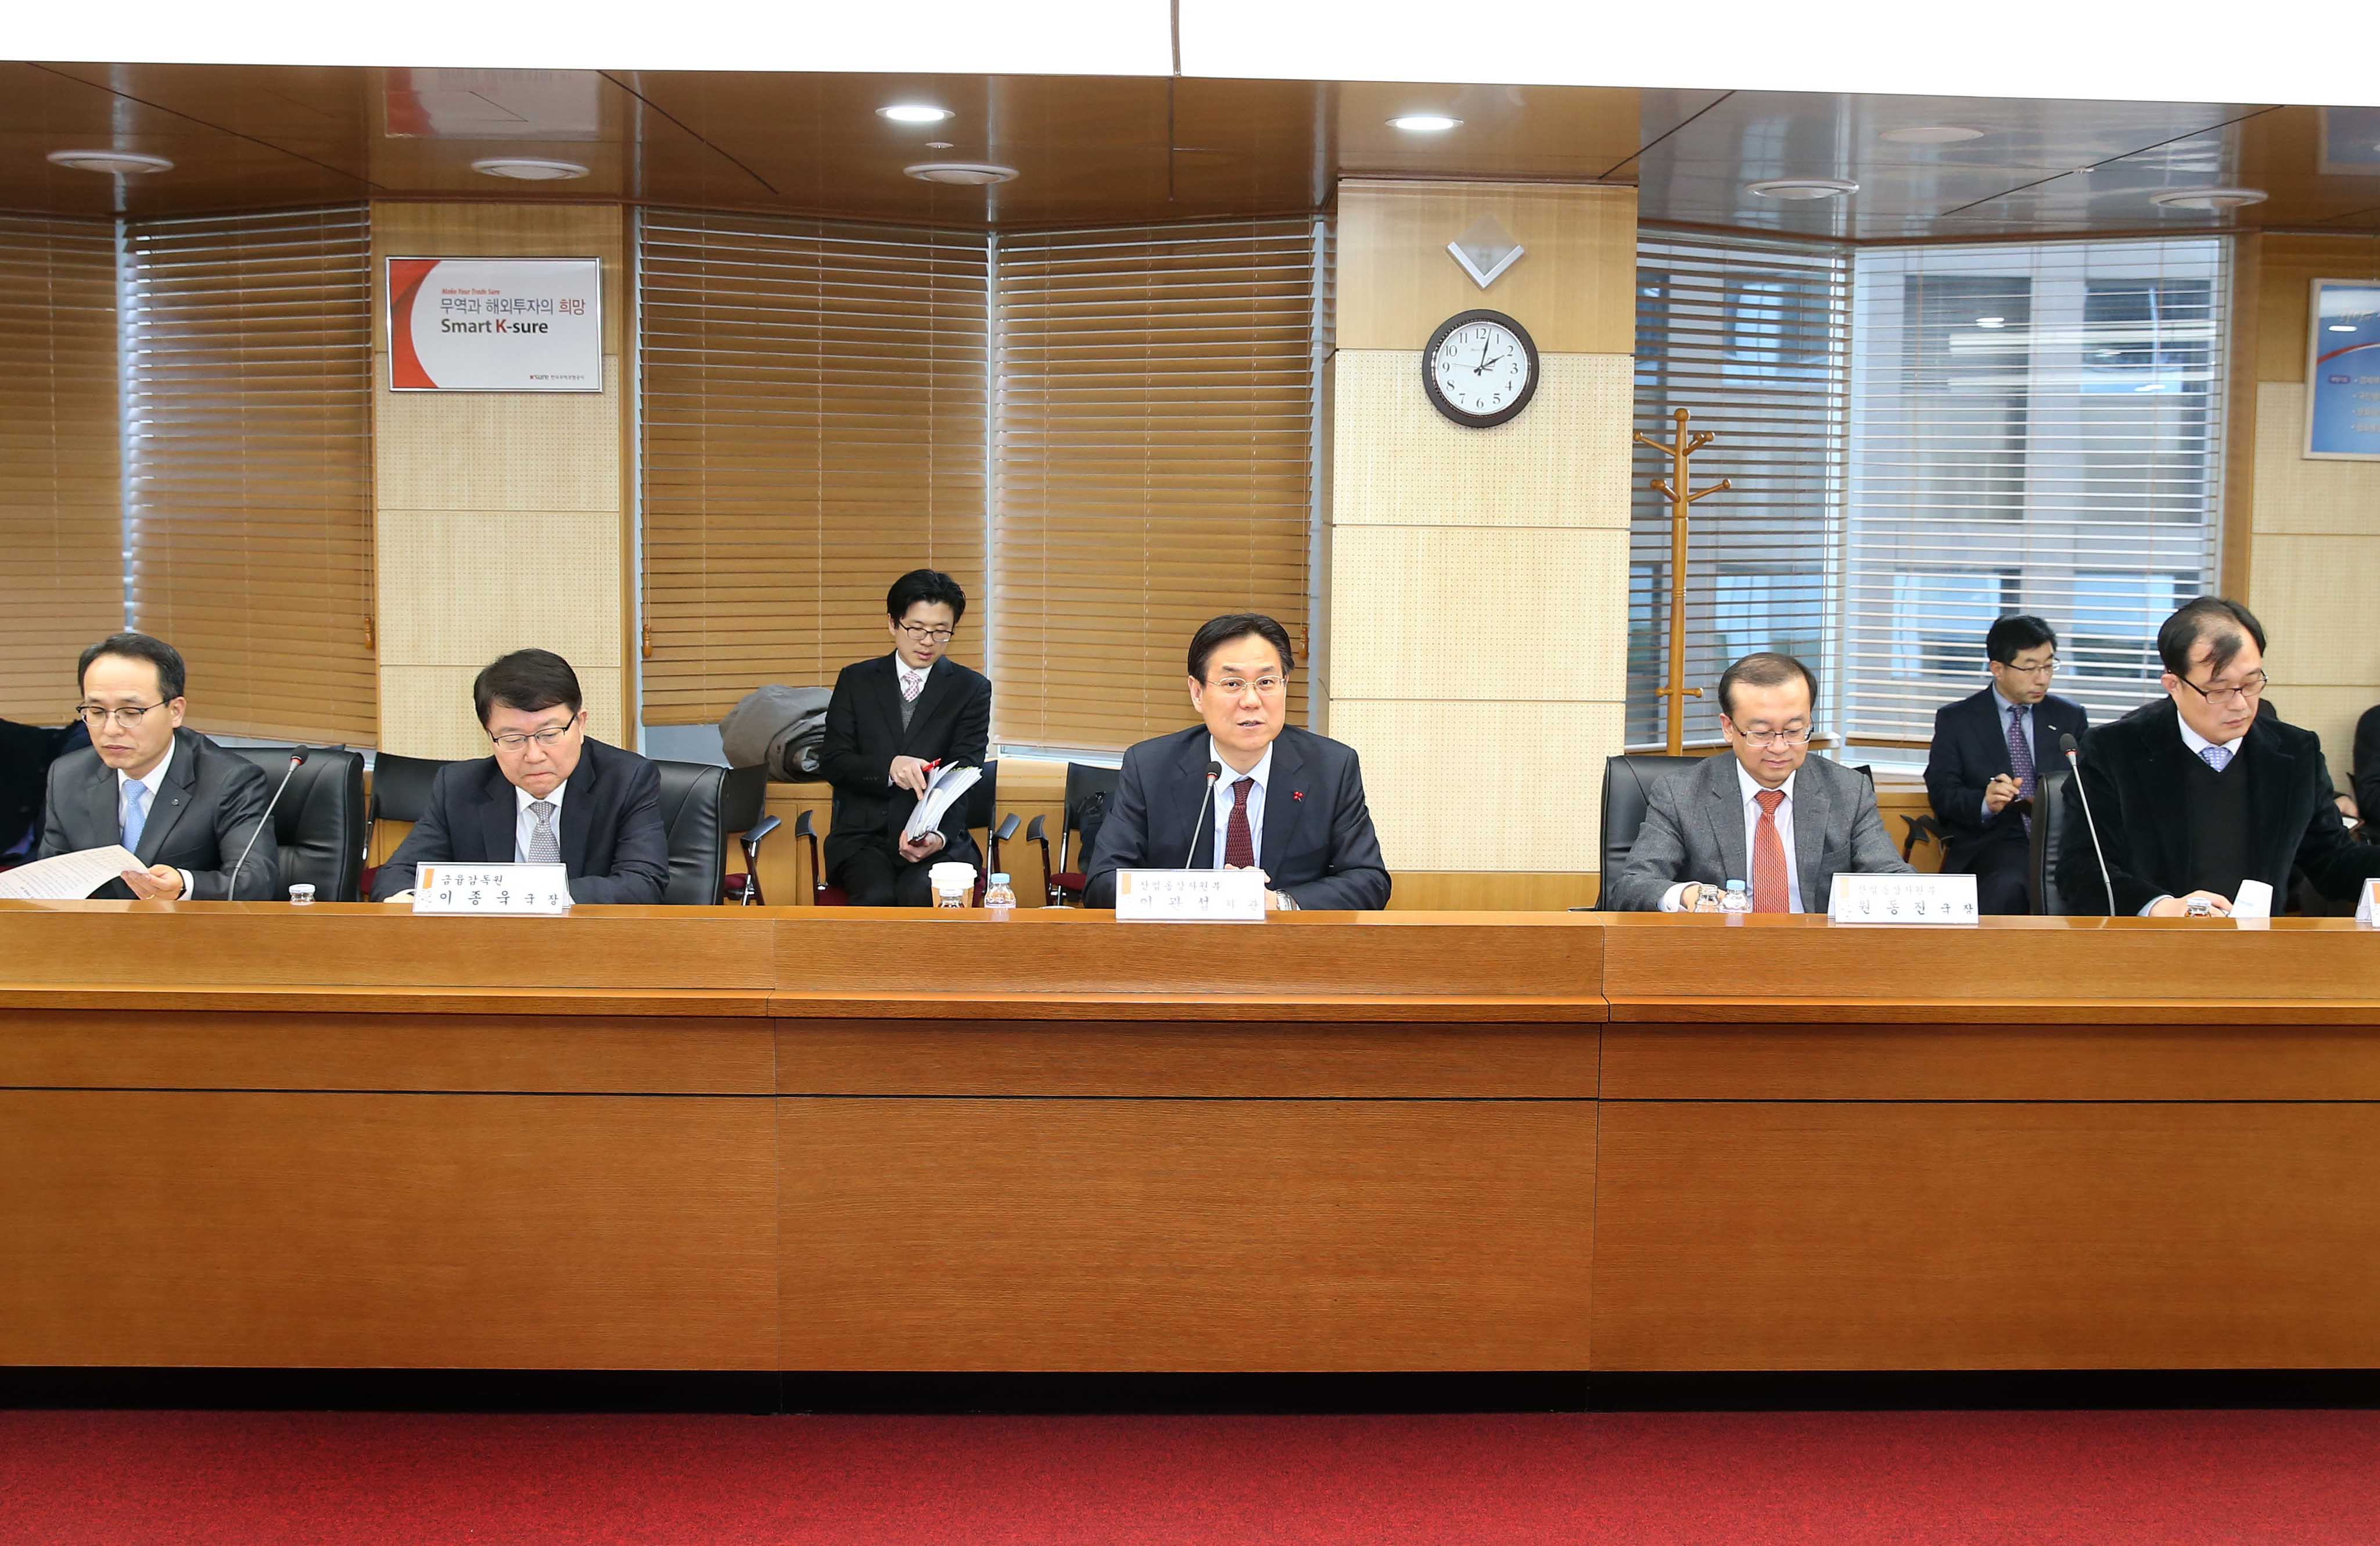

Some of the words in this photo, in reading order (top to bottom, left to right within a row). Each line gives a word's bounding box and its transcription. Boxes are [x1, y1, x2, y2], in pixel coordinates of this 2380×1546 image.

[440, 297, 481, 315] 무역과
[486, 297, 554, 315] 해외투자의
[559, 298, 586, 315] 희망
[441, 318, 492, 333] Smart
[496, 319, 548, 334] K-sure
[1459, 332, 1467, 343] 11
[1476, 328, 1487, 339] 12
[1445, 345, 1458, 357] 10
[1506, 345, 1514, 356] 2
[1442, 363, 1450, 372] 9
[1510, 363, 1518, 374] 3
[1446, 380, 1455, 391] 8
[1505, 381, 1513, 390] 4
[1459, 393, 1466, 404] 7
[1476, 397, 1484, 408] 6
[1493, 393, 1500, 404] 5
[441, 874, 502, 886] 금융감독원
